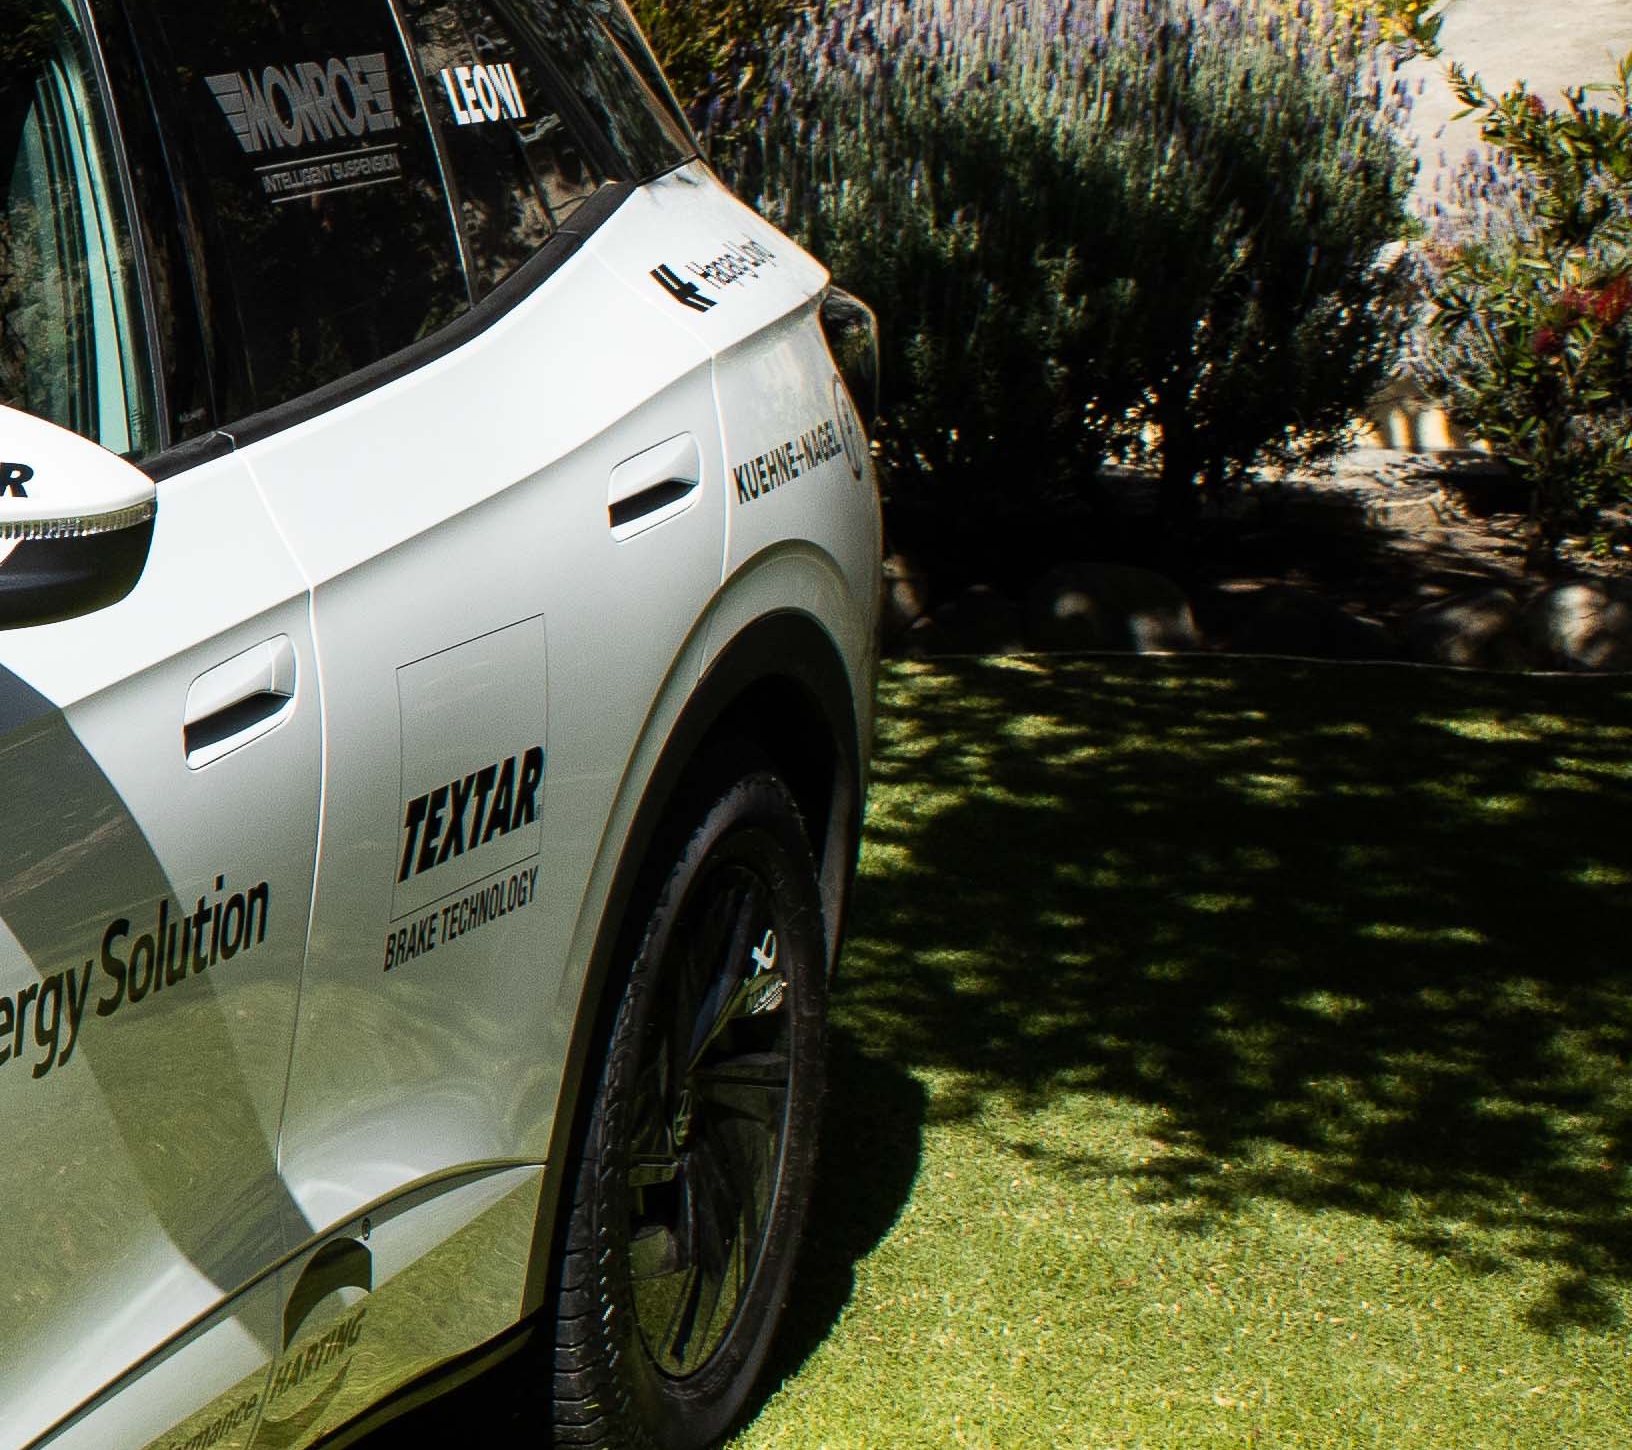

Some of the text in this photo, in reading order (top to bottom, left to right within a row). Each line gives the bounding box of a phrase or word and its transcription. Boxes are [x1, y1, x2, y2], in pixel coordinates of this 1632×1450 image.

[440, 63, 526, 126] LEONI
[398, 746, 545, 884] TEXTAR
[97, 873, 269, 1019] Solution
[384, 865, 539, 972] BRAKE TECHNOLOGY
[269, 1307, 367, 1403] HARTING
